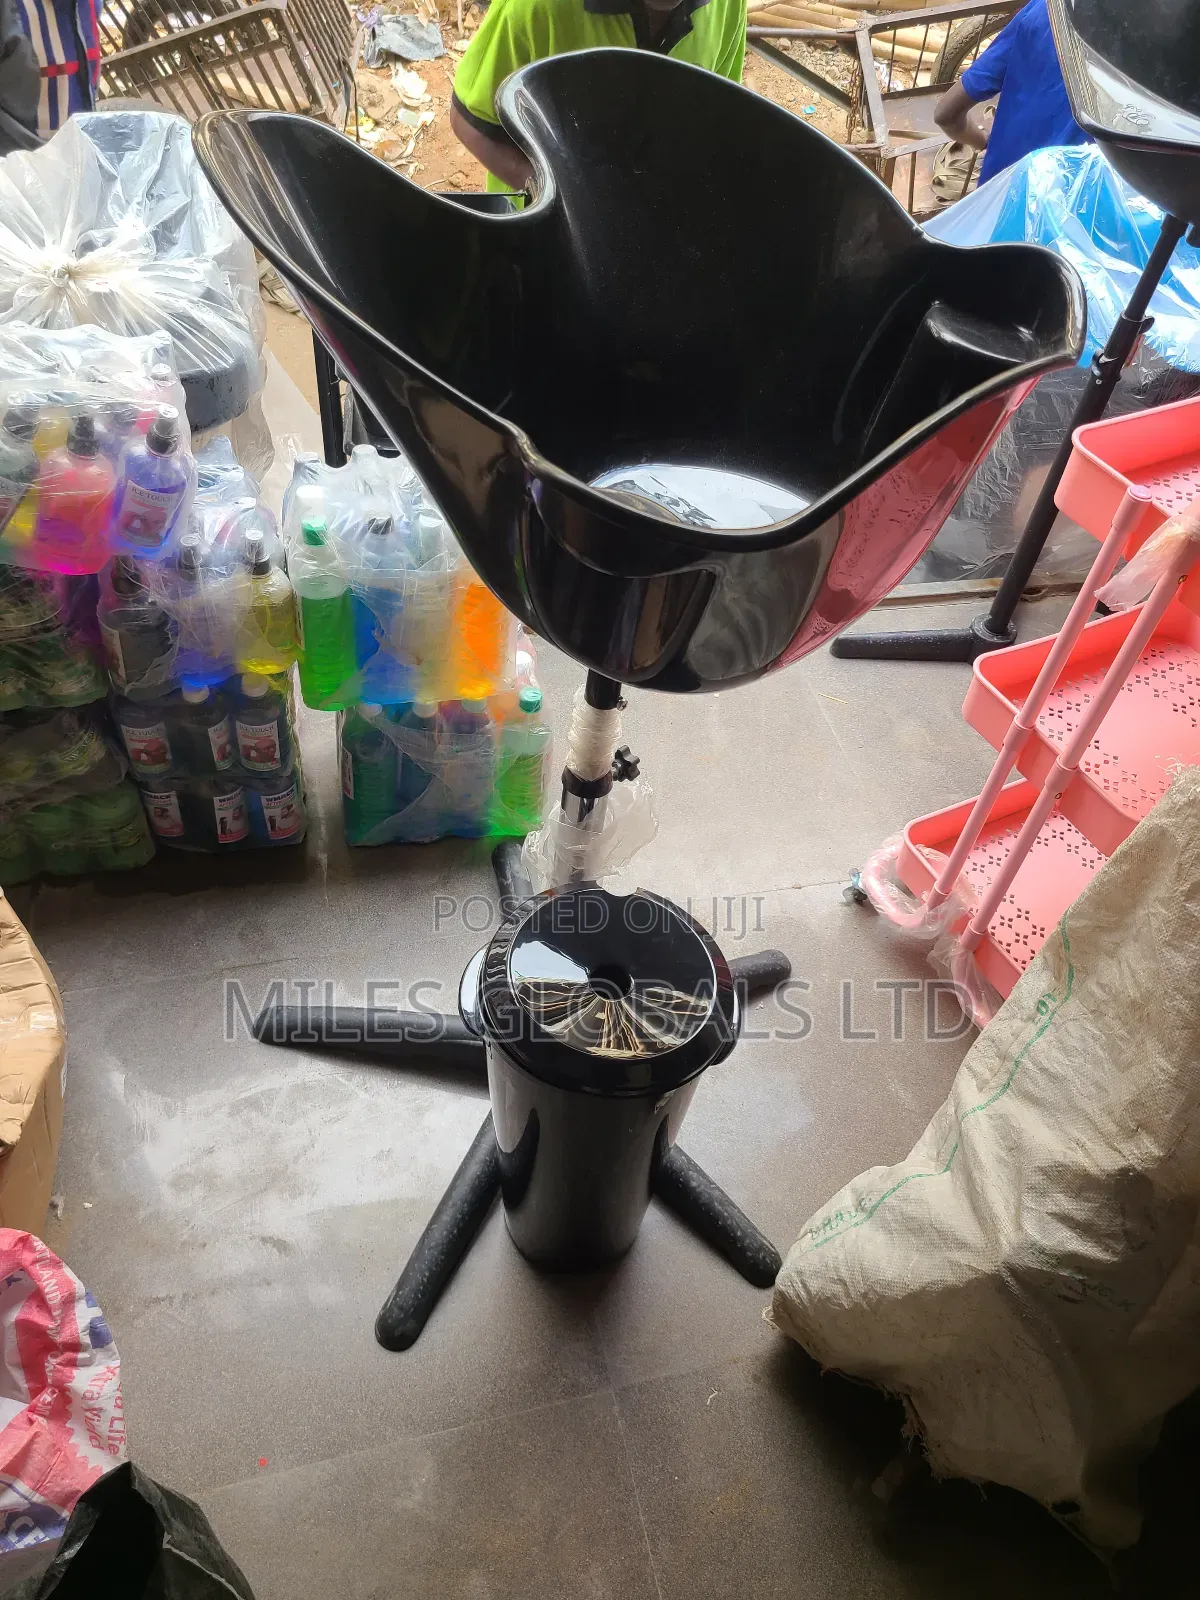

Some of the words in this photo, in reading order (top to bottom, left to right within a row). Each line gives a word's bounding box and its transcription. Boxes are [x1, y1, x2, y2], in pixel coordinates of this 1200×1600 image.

[131, 486, 144, 497] ICE
[250, 724, 275, 733] TOUCH
[265, 787, 295, 803] WMACK
